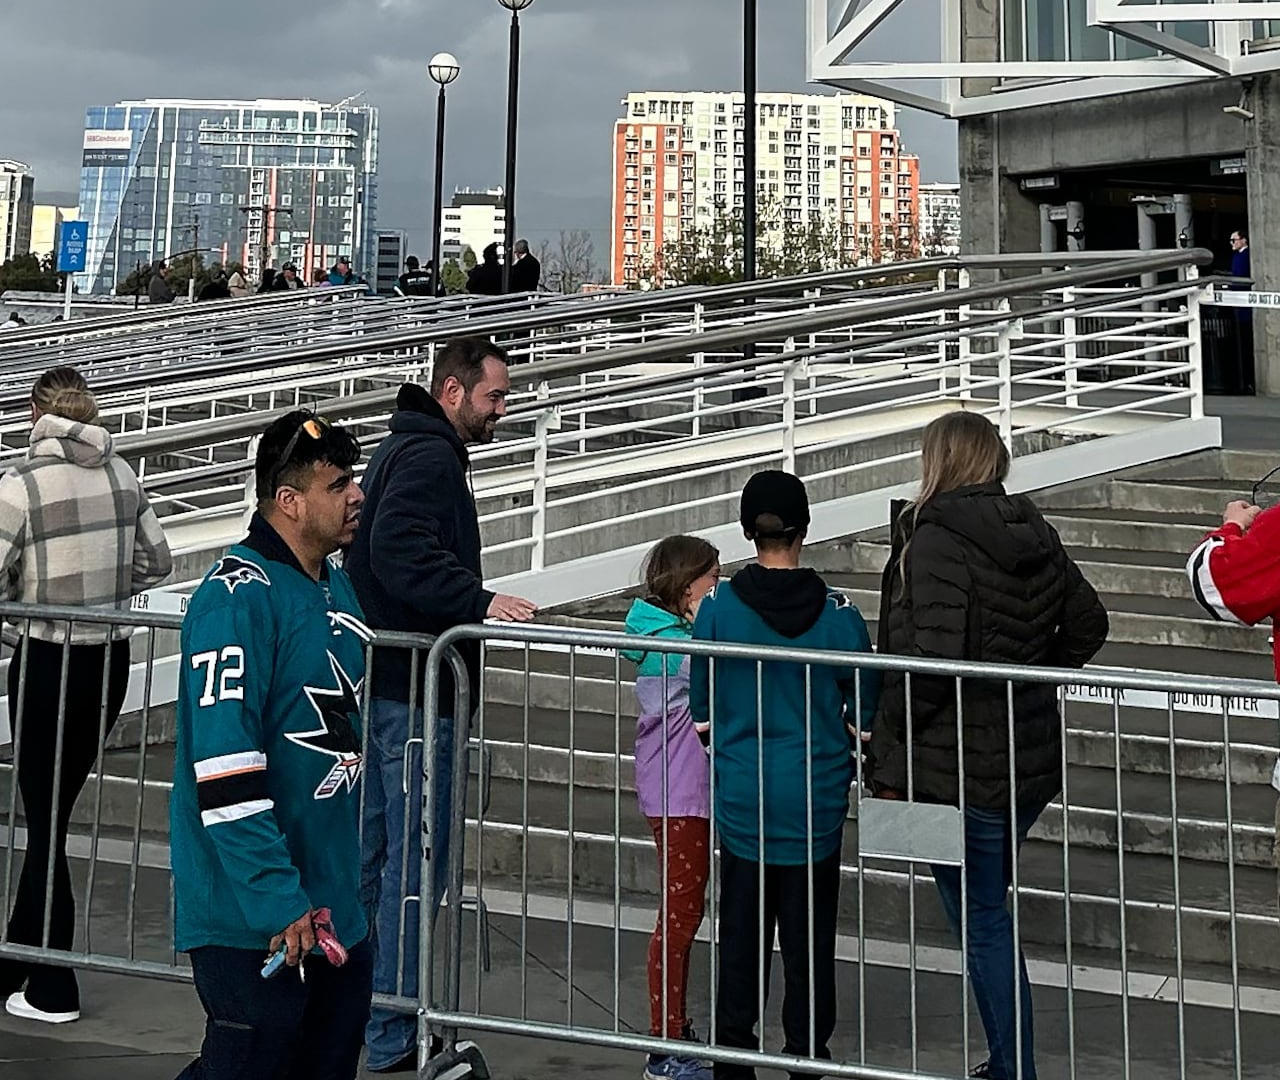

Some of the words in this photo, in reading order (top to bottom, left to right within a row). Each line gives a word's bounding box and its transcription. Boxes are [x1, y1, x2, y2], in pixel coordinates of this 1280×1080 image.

[1248, 294, 1257, 303] DO
[1259, 295, 1271, 304] NOT
[191, 646, 245, 707] 72
